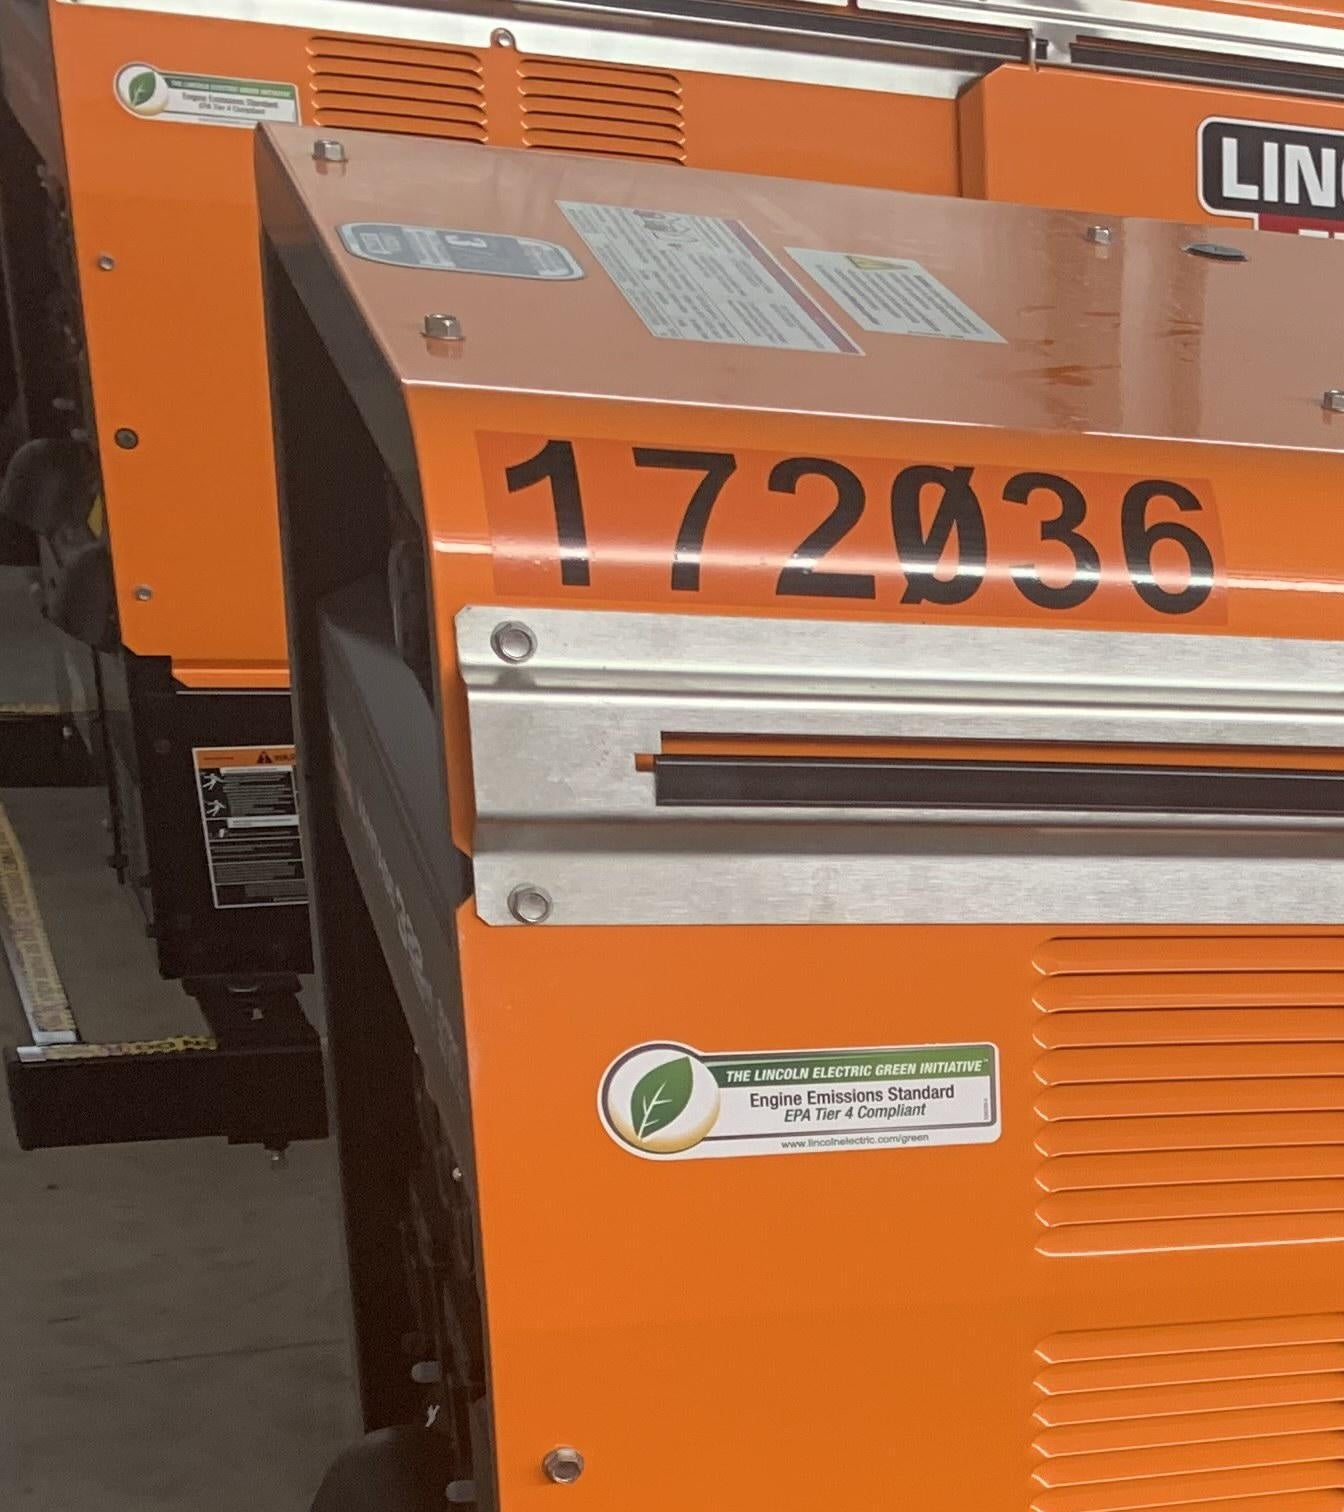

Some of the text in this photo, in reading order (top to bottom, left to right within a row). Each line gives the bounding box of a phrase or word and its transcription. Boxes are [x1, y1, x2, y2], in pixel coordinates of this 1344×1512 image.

[726, 1070, 752, 1083] THE
[754, 1067, 809, 1082] LINCOLN
[813, 1064, 872, 1080] ELECTRIC
[875, 1062, 917, 1078] GREEN
[750, 1084, 955, 1110] Engine Emissions Standard
[784, 1103, 927, 1123] EPA Tier 4 Compliant
[781, 1133, 929, 1149] www.lincolnelectric.com/green
